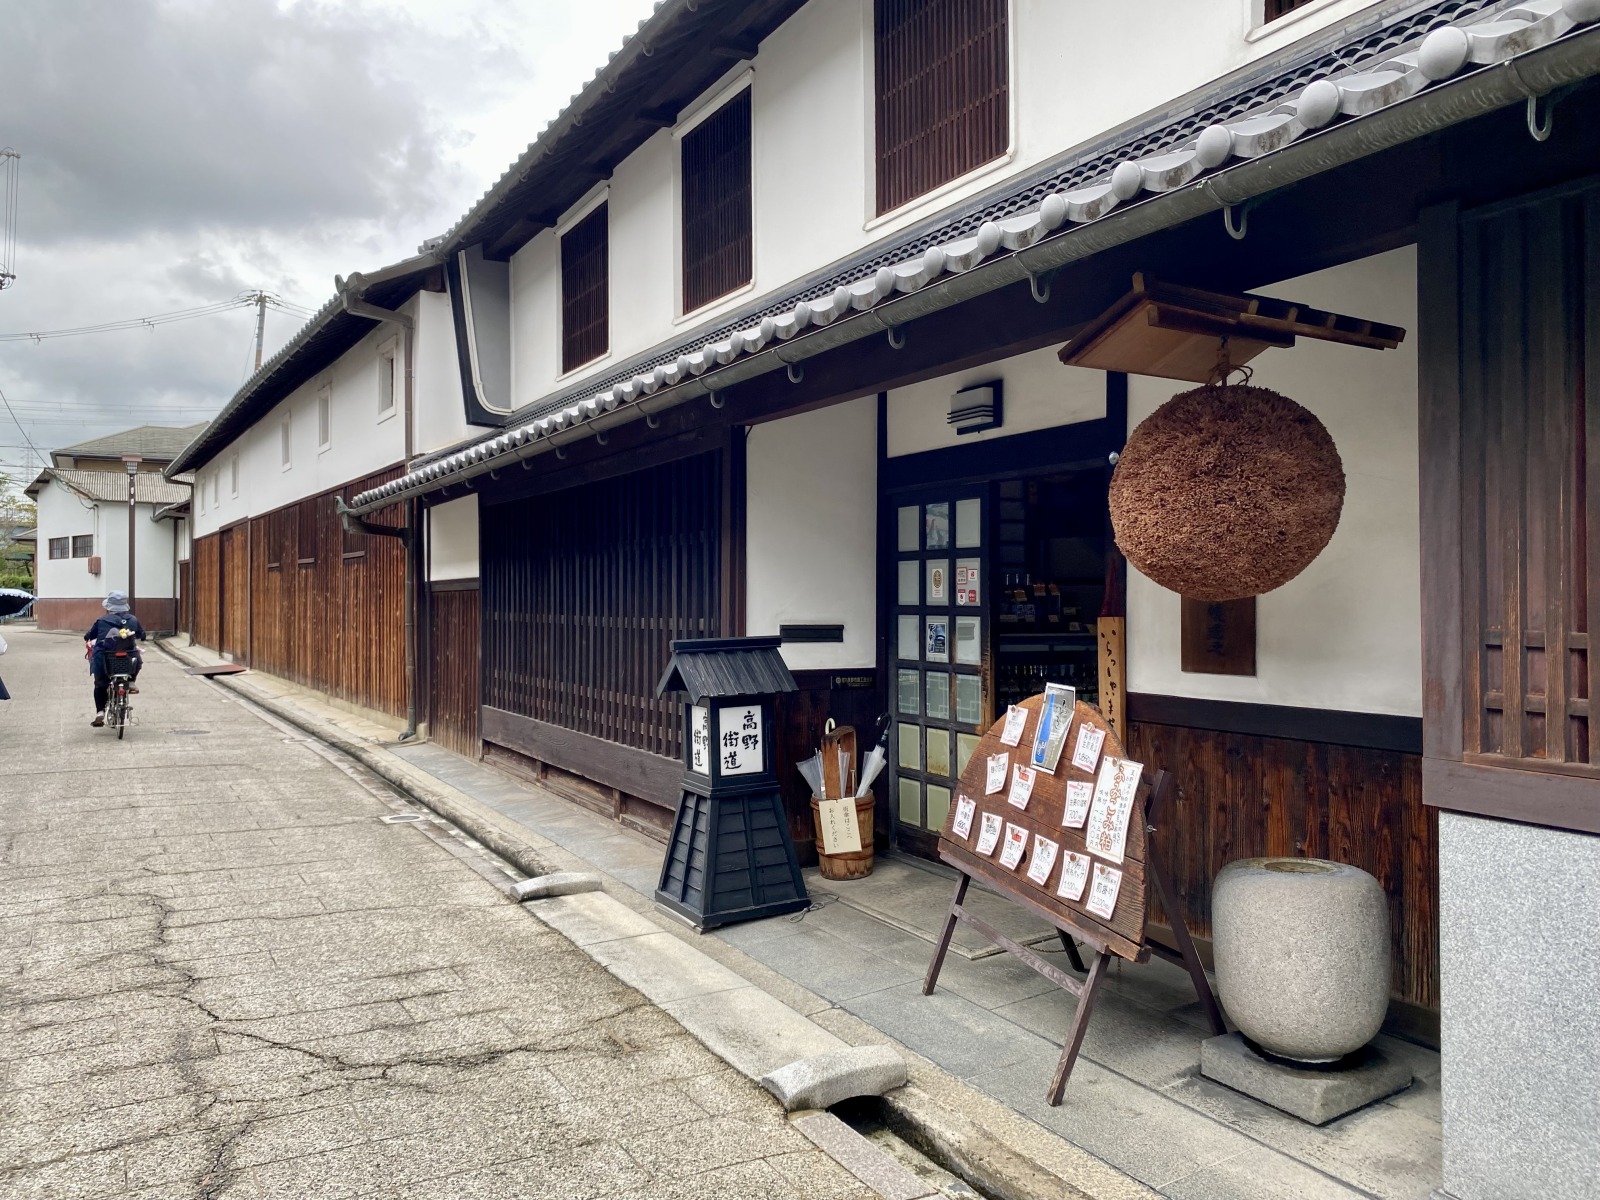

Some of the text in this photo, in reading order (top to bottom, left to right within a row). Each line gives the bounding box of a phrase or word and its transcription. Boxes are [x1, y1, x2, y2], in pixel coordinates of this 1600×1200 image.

[742, 710, 759, 750] 高野
[723, 731, 742, 770] 街道
[829, 807, 840, 849] お入れください
[1096, 882, 1114, 897] 前掛け
